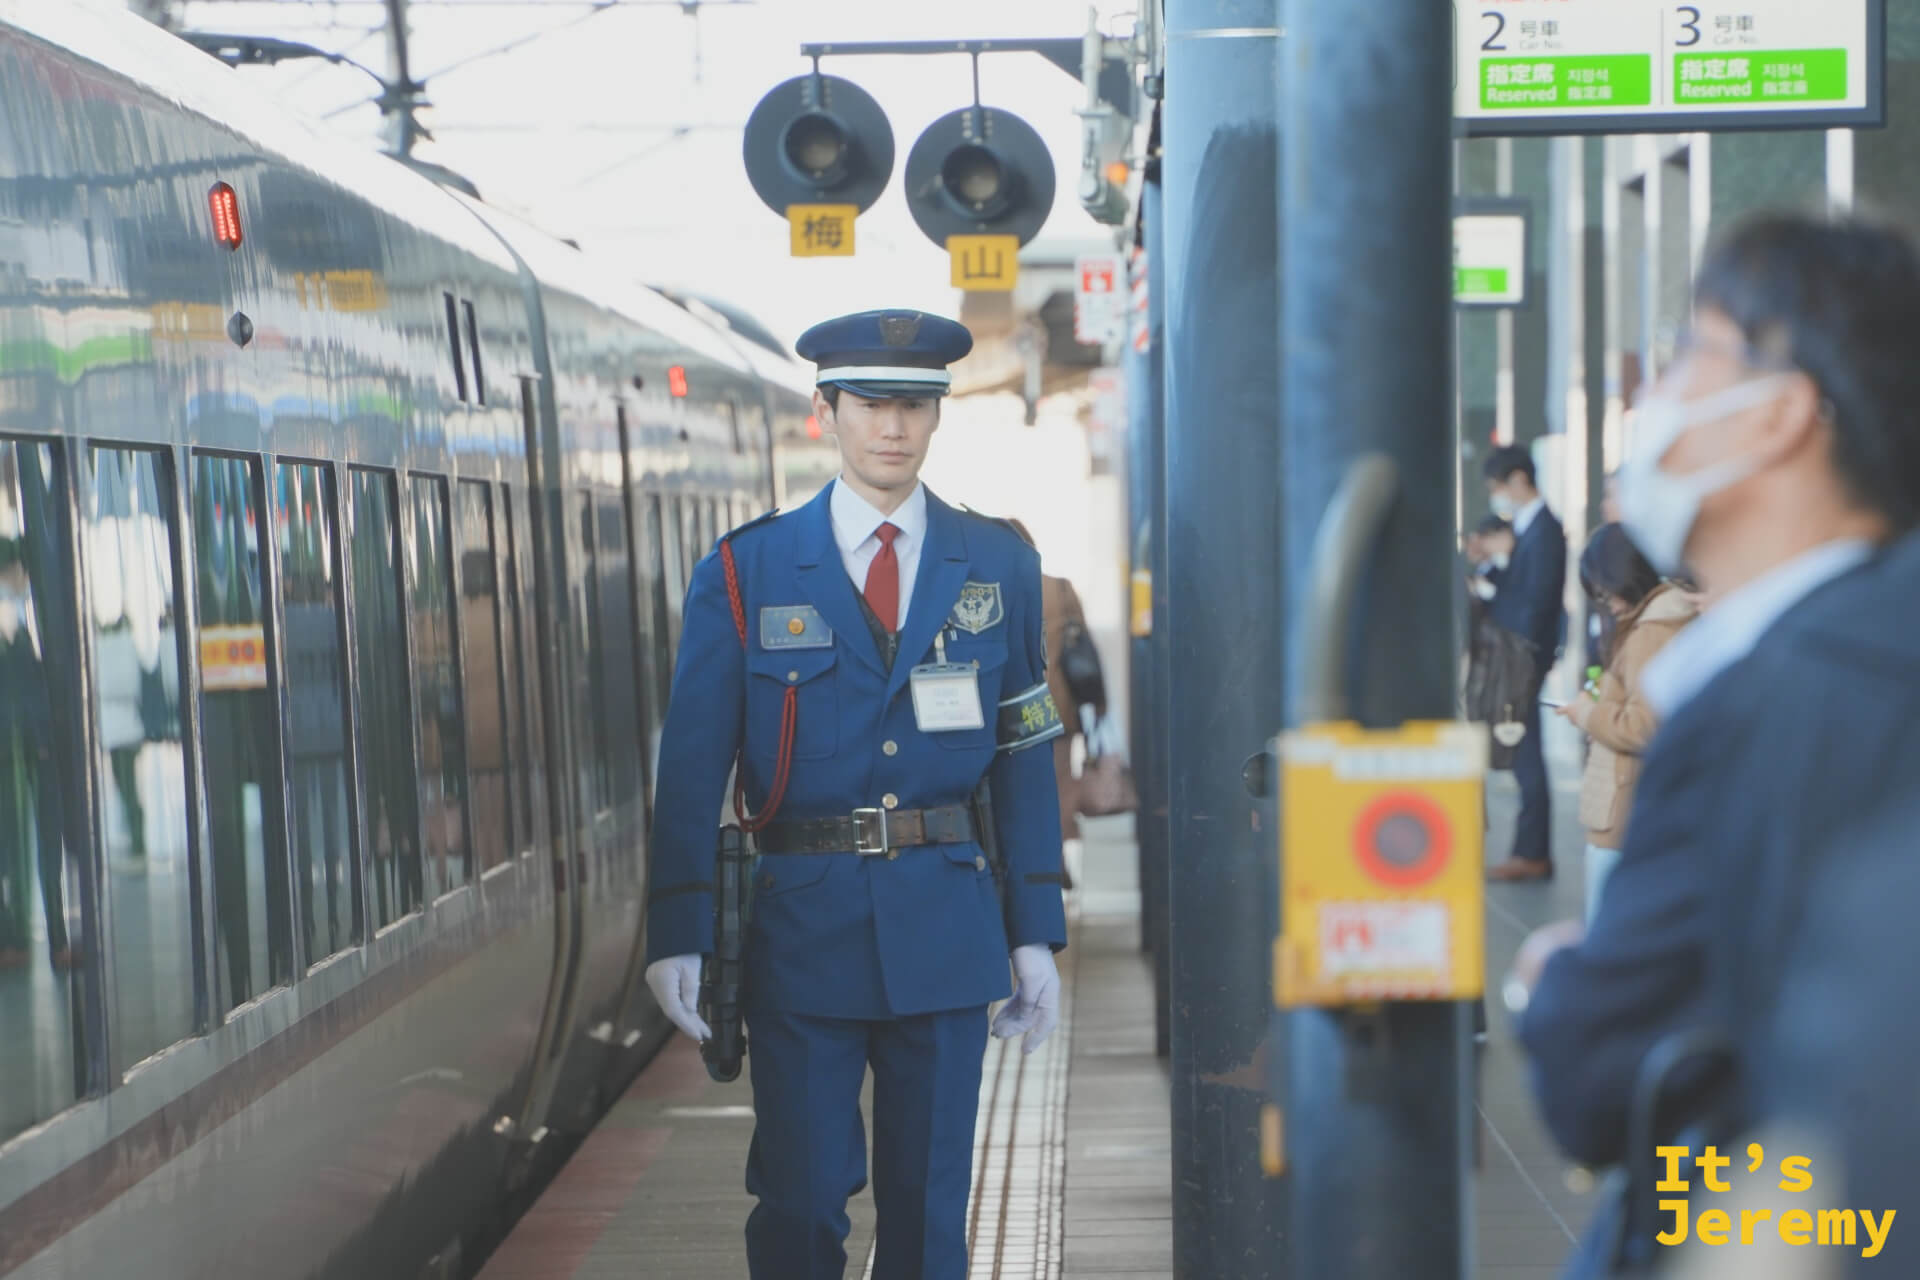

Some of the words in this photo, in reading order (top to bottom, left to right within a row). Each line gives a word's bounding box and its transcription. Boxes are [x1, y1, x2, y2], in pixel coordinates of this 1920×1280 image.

[1481, 11, 1507, 51] 2
[1519, 20, 1559, 38] 号車
[1675, 6, 1701, 46] 3
[1714, 15, 1754, 32] 号車
[1486, 63, 1556, 85] 指定席
[1681, 58, 1751, 80] 指定席
[1486, 86, 1557, 103] Reserved
[1681, 81, 1752, 98] Reserved
[803, 213, 843, 249] 梅
[962, 245, 1003, 279] 山
